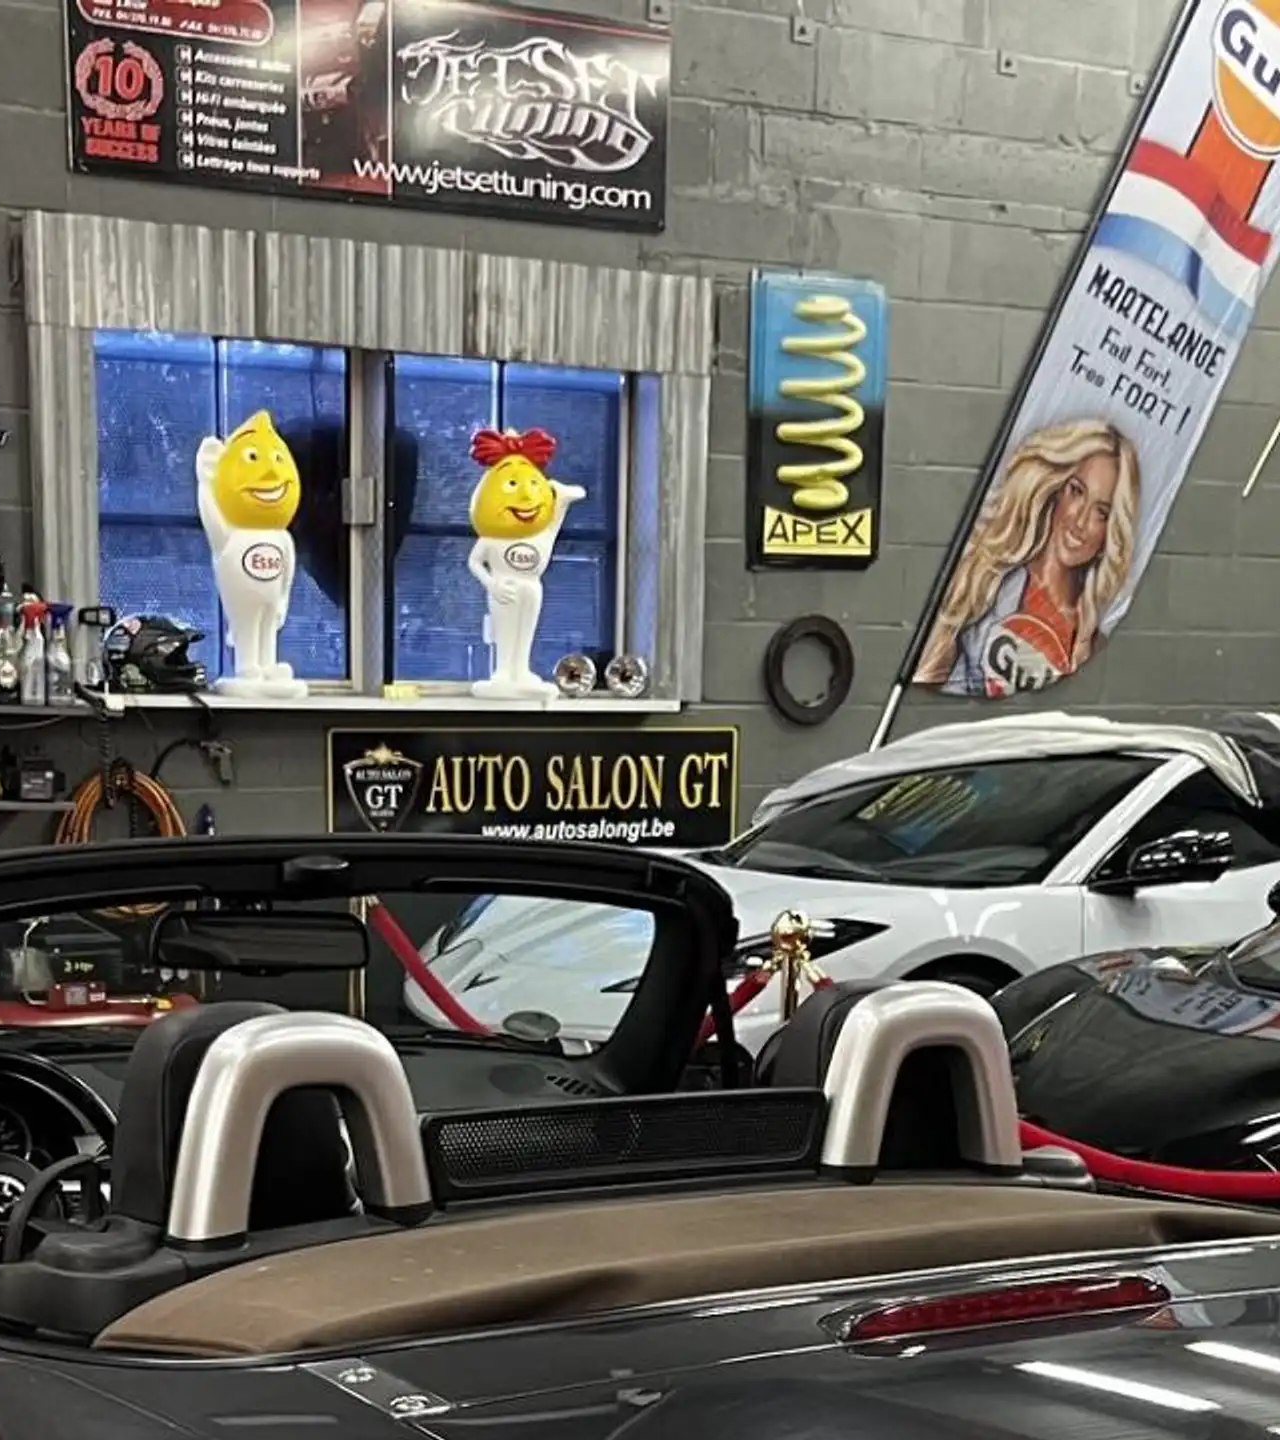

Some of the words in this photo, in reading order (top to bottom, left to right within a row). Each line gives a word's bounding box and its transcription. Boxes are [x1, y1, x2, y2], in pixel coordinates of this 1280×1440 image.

[95, 55, 145, 100] 10
[352, 158, 652, 210] www.jetsettuning.com
[766, 512, 866, 546] APEX
[365, 784, 403, 809] GT
[425, 752, 532, 814] AUTO
[545, 753, 665, 812] SALON
[678, 751, 729, 809] GT
[481, 818, 676, 843] www.autosalongt.be
